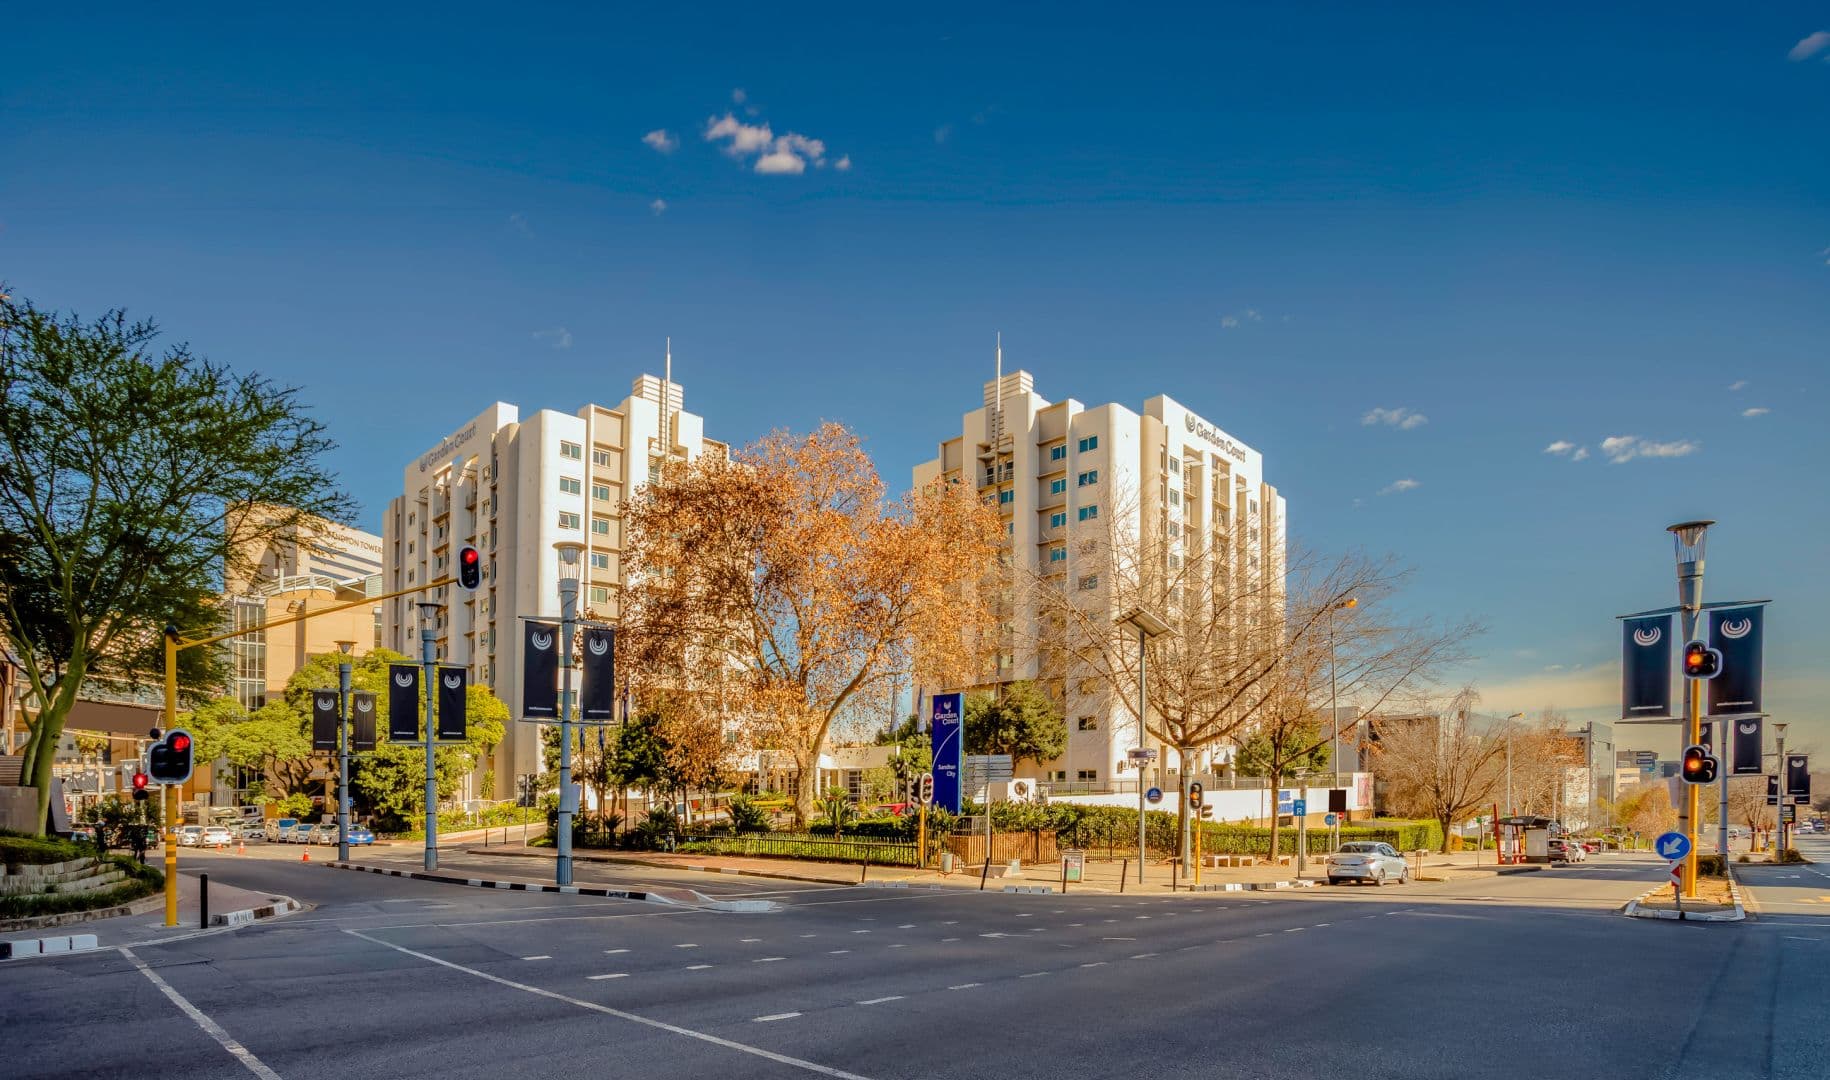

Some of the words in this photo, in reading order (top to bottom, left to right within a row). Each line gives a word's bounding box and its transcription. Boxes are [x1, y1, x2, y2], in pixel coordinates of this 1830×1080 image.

[455, 422, 477, 448] Court
[1196, 422, 1226, 451] Garden
[1225, 440, 1246, 463] Court
[934, 709, 958, 719] Garden
[942, 717, 959, 726] Court
[1296, 807, 1303, 815] R
